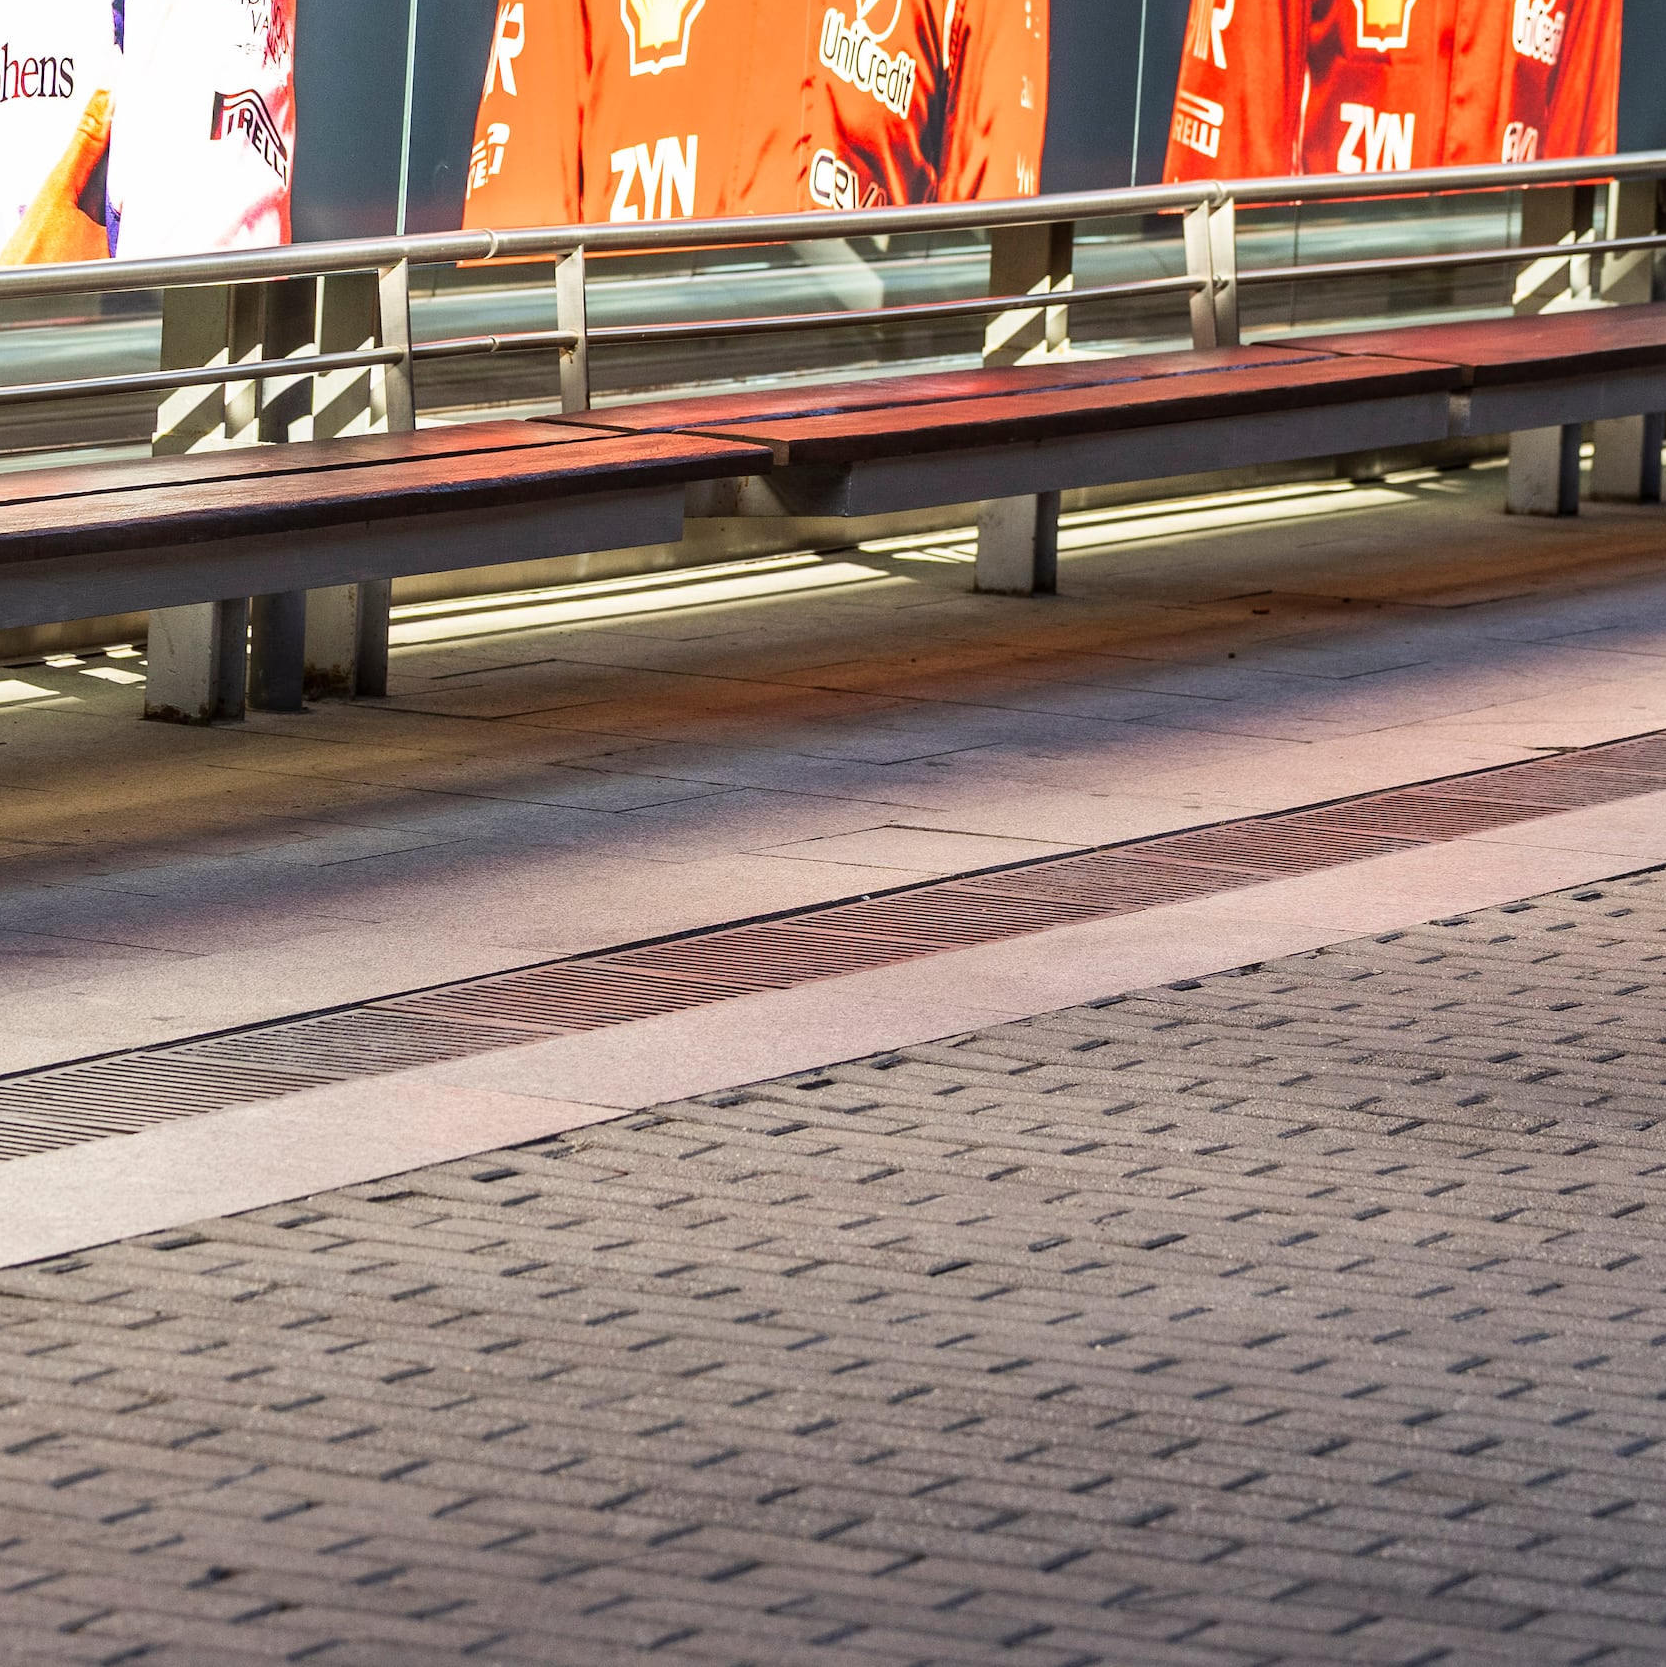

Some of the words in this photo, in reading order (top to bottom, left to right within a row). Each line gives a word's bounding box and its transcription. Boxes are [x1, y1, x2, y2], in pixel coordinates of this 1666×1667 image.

[822, 11, 915, 117] UniCredit
[610, 134, 699, 221] ZYN
[1336, 102, 1415, 173] ZYN
